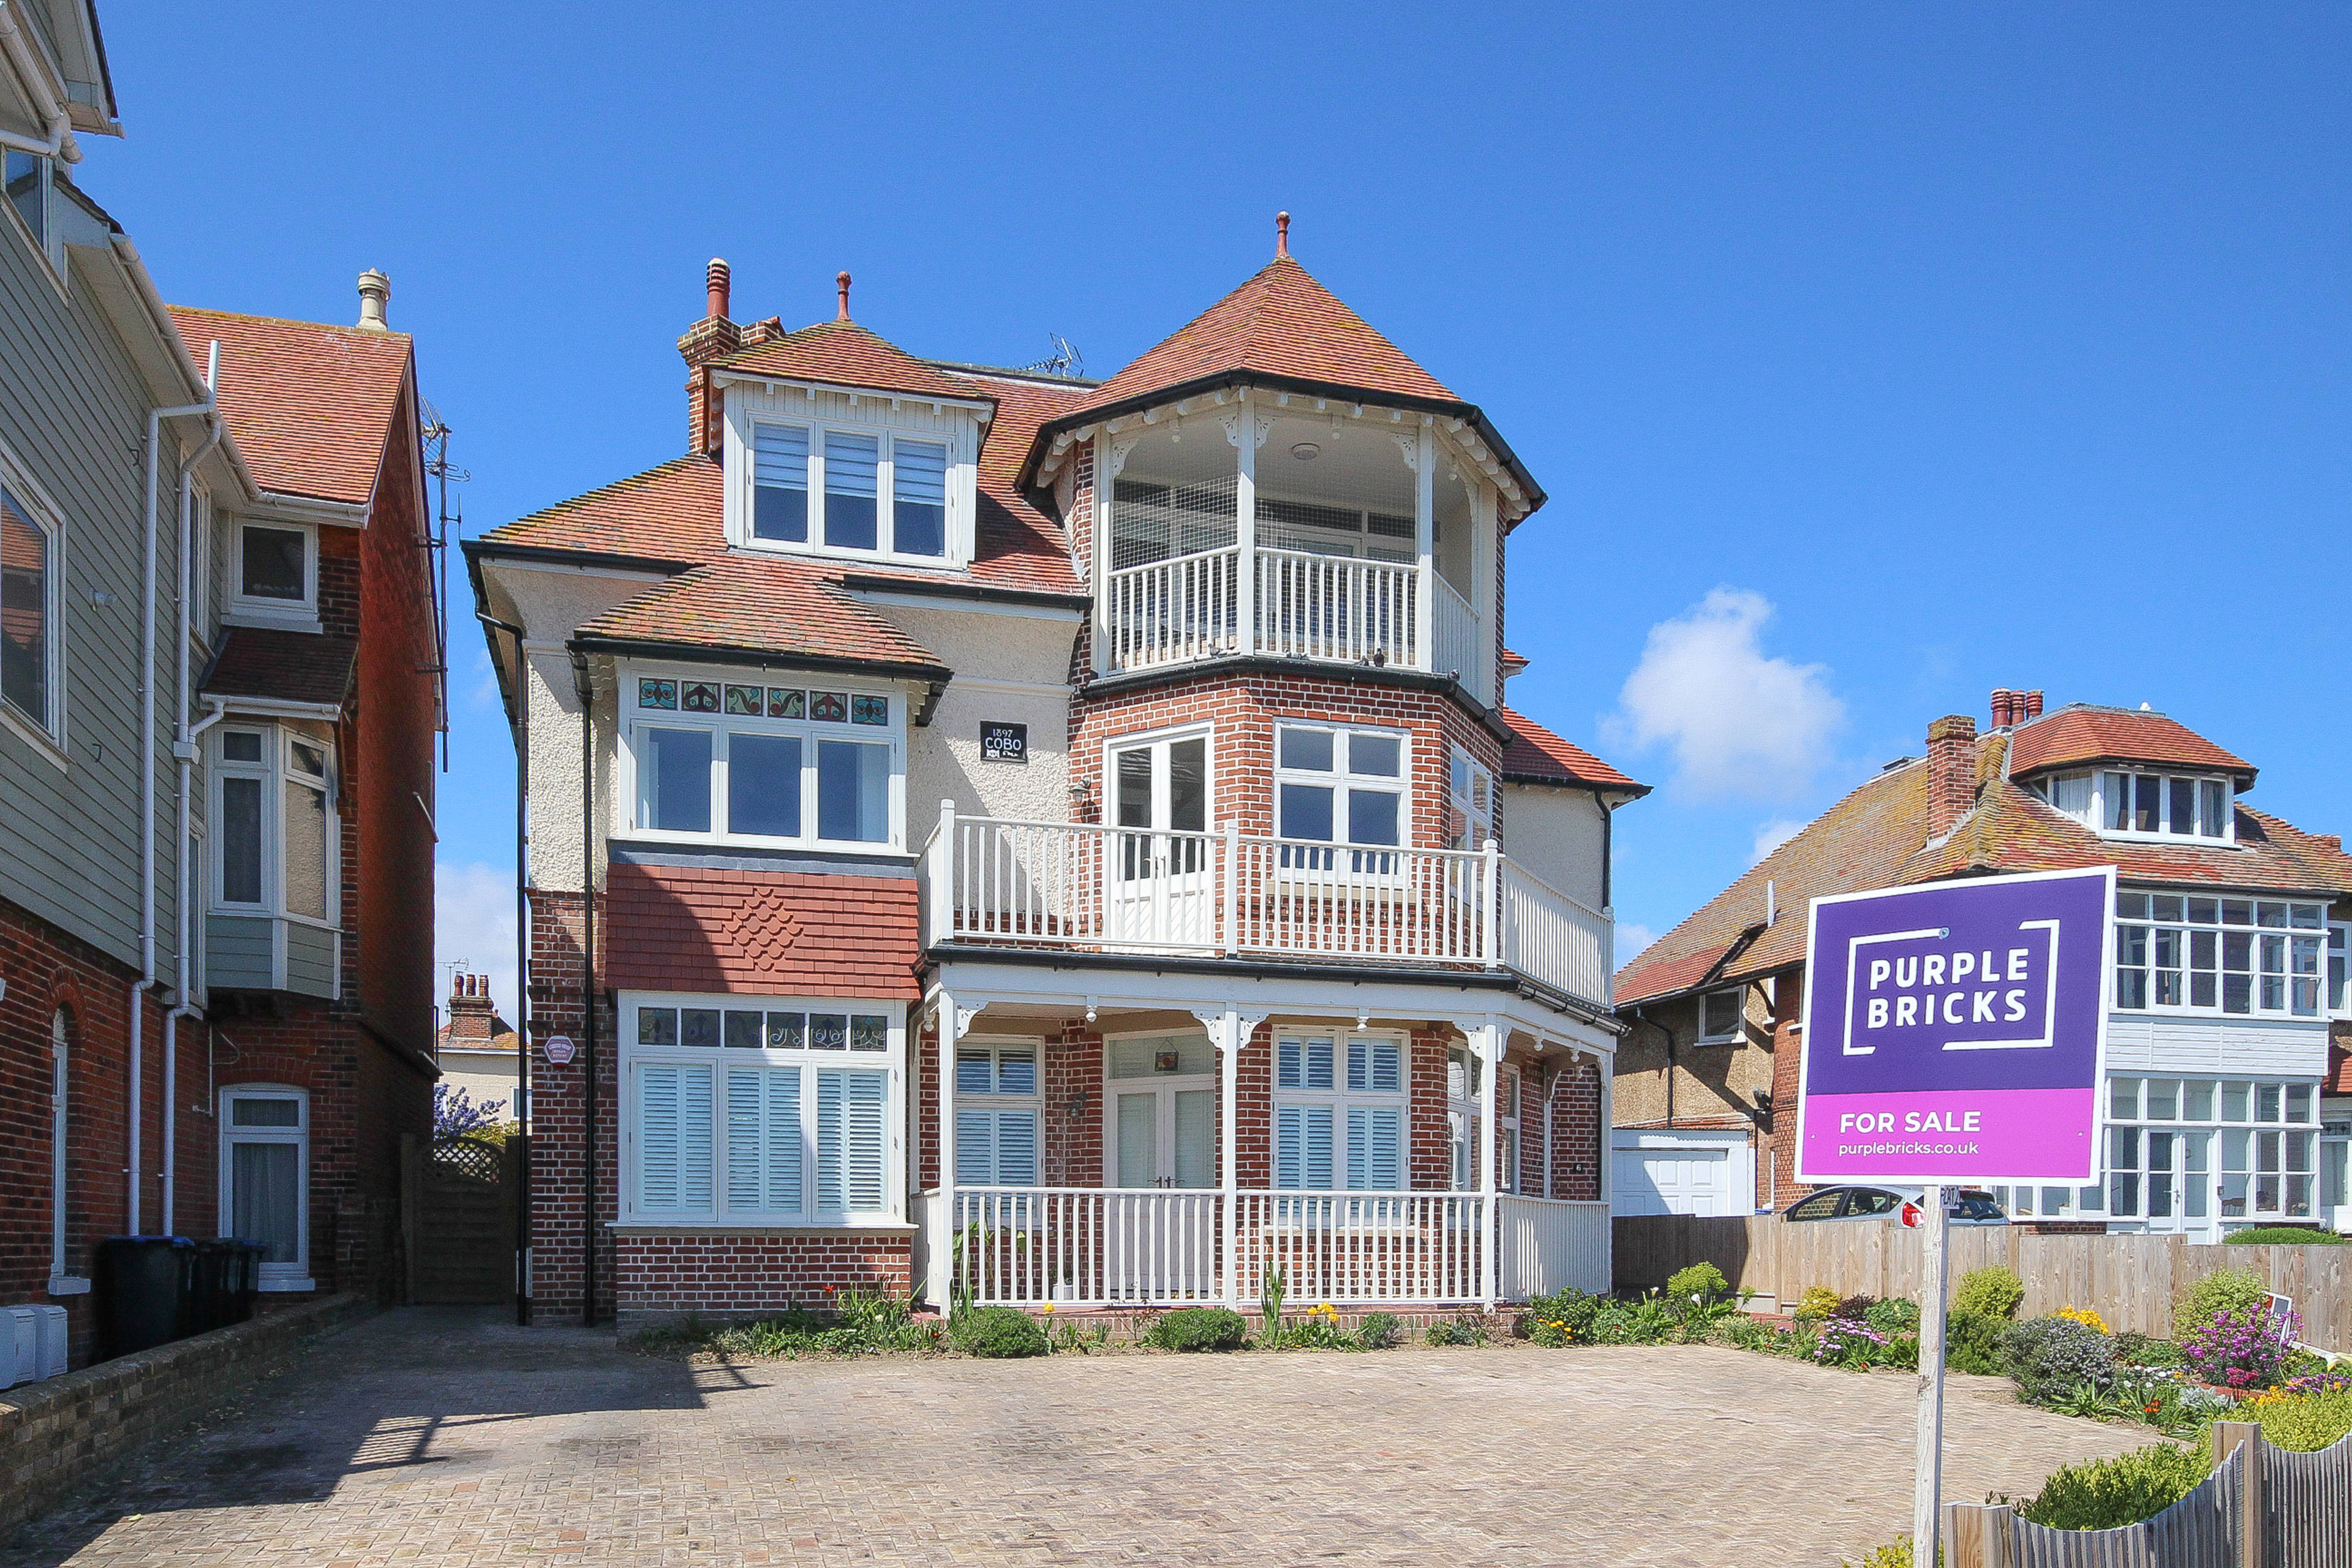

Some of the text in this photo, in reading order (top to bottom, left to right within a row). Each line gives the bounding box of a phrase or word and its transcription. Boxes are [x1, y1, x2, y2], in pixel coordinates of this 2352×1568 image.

[992, 728, 1014, 738] 1897
[985, 737, 1022, 751] COBO
[1869, 948, 2029, 990] PURPLE
[1867, 989, 2027, 1029] BRICKS
[1839, 1110, 1981, 1133] FOR SALE
[1839, 1141, 1979, 1157] purplebricks.co.uk
